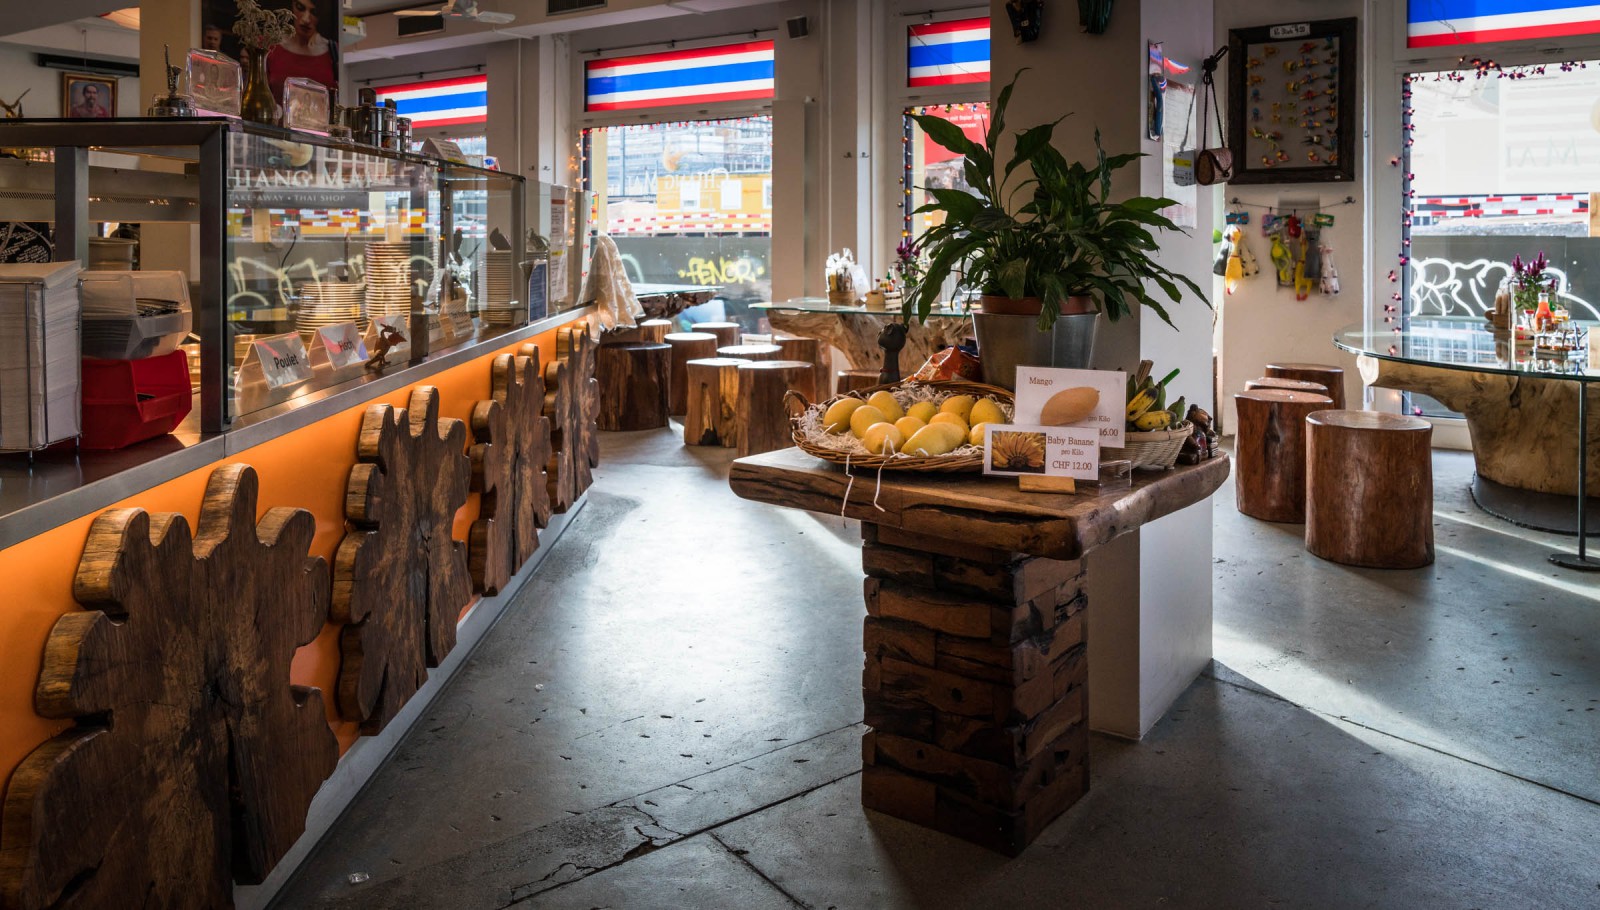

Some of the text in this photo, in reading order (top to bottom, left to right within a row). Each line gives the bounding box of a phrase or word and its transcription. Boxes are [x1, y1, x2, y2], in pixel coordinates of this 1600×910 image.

[294, 194, 317, 202] THAI
[320, 194, 346, 202] SHOP
[273, 353, 299, 370] Poulet
[1029, 377, 1053, 386] Mango
[1047, 436, 1094, 446] Baby Banane
[1071, 448, 1084, 456] Kilo
[1052, 461, 1092, 470] CHF 12.00
